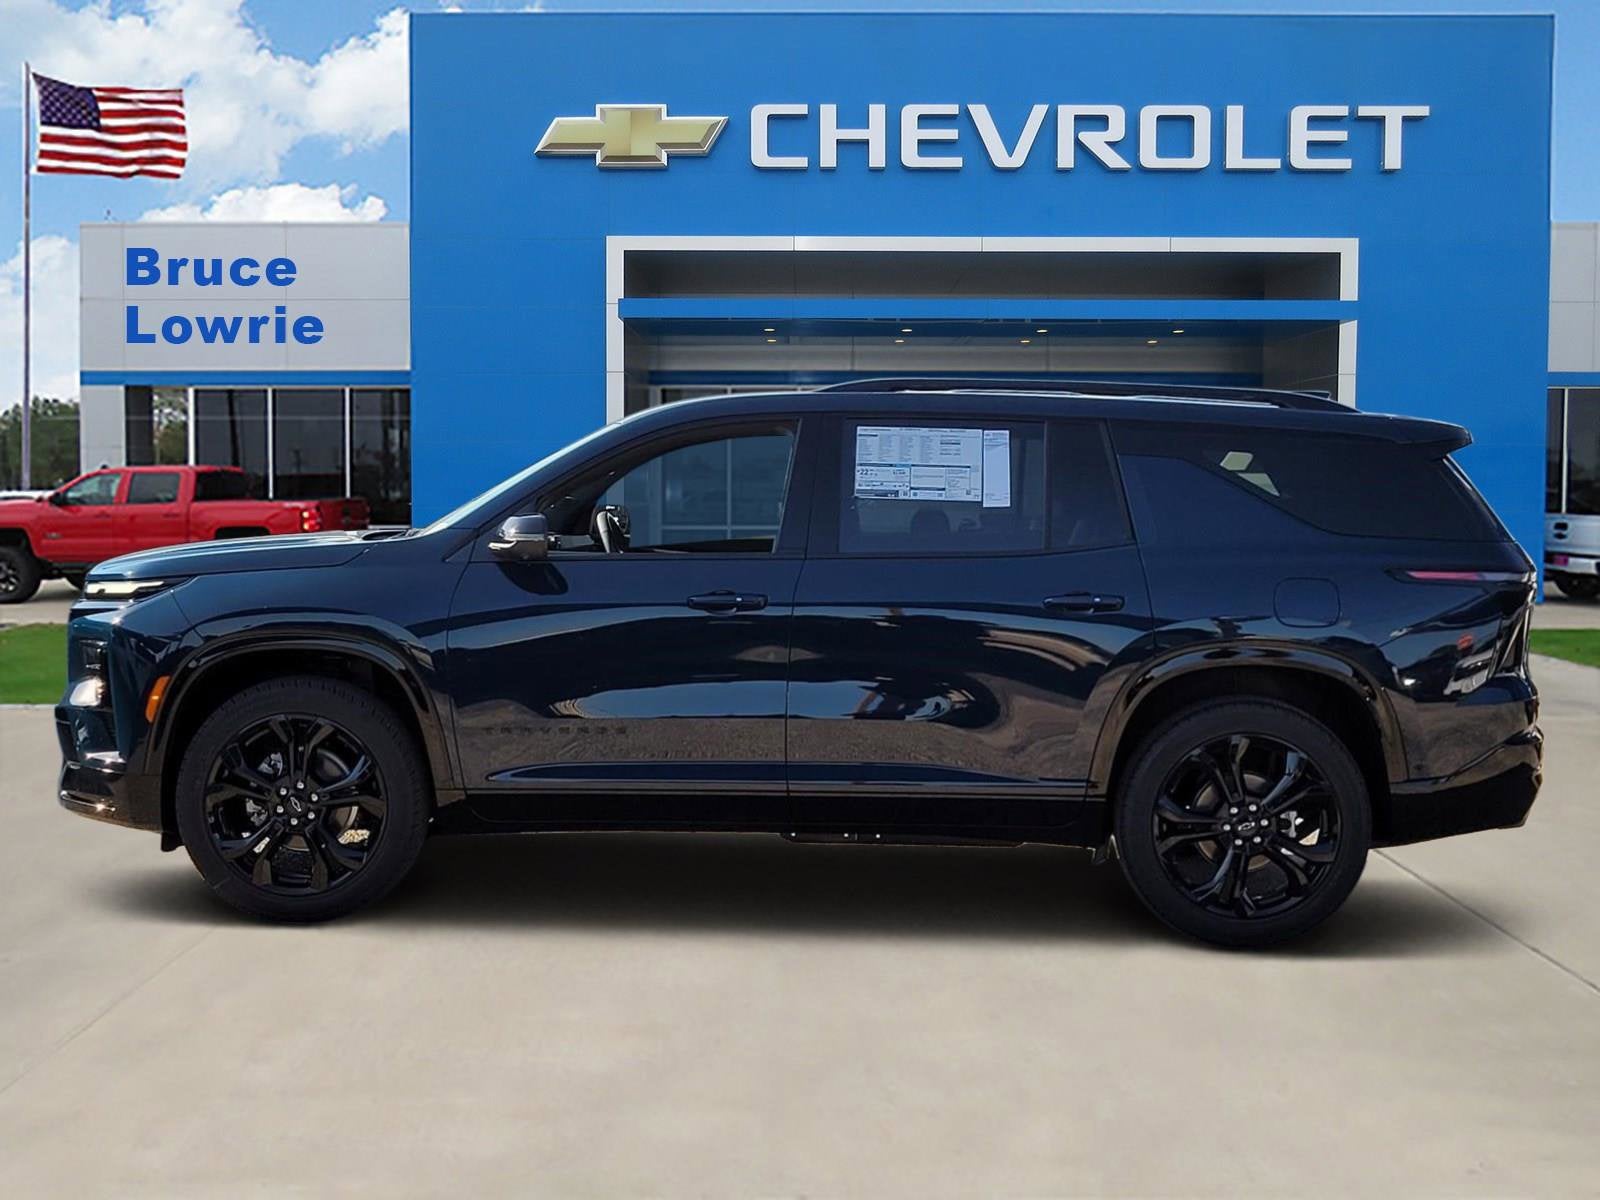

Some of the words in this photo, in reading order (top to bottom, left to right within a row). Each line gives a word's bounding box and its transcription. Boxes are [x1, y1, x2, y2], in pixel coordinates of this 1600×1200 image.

[751, 103, 1430, 170] CHEVROLET
[126, 248, 297, 286] Bruce
[126, 305, 324, 344] Lowrie
